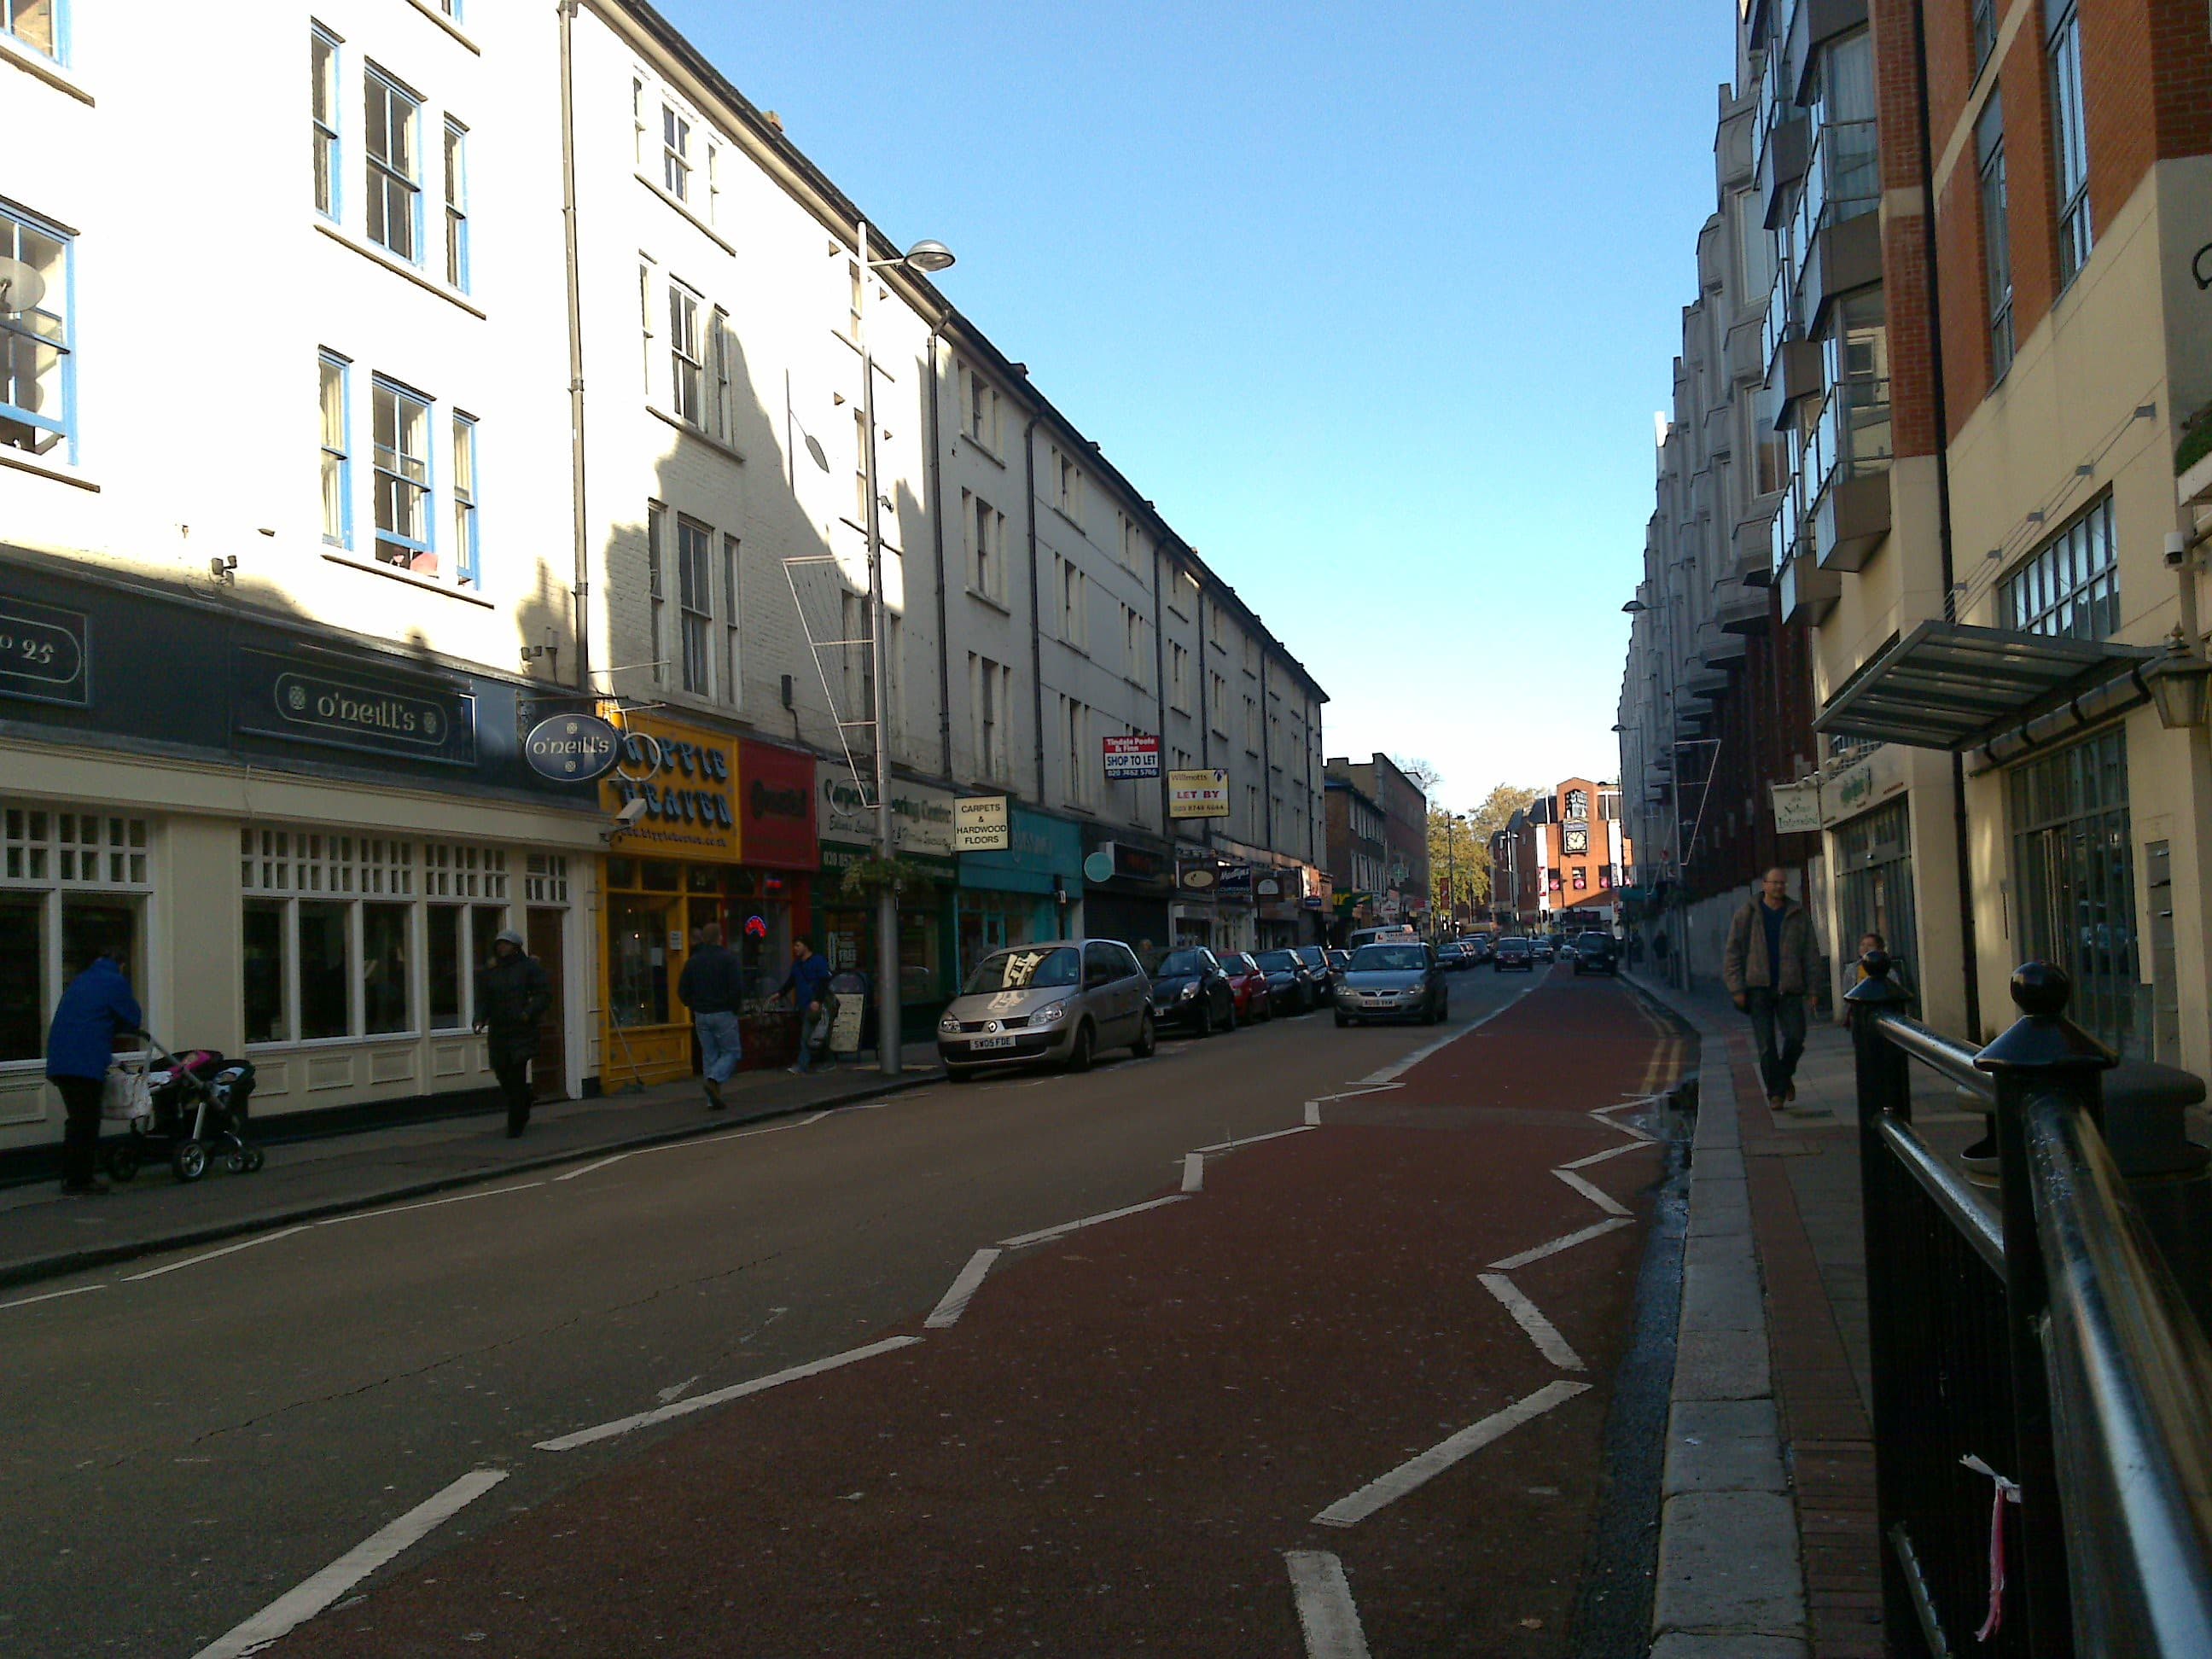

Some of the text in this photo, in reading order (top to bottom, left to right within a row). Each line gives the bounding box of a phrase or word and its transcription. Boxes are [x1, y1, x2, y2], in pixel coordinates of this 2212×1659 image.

[1107, 754, 1155, 766] SHOP TO LET
[961, 804, 1000, 813] CARPETS
[957, 825, 1007, 834] HARDWOOD
[964, 835, 999, 844] FLOORS
